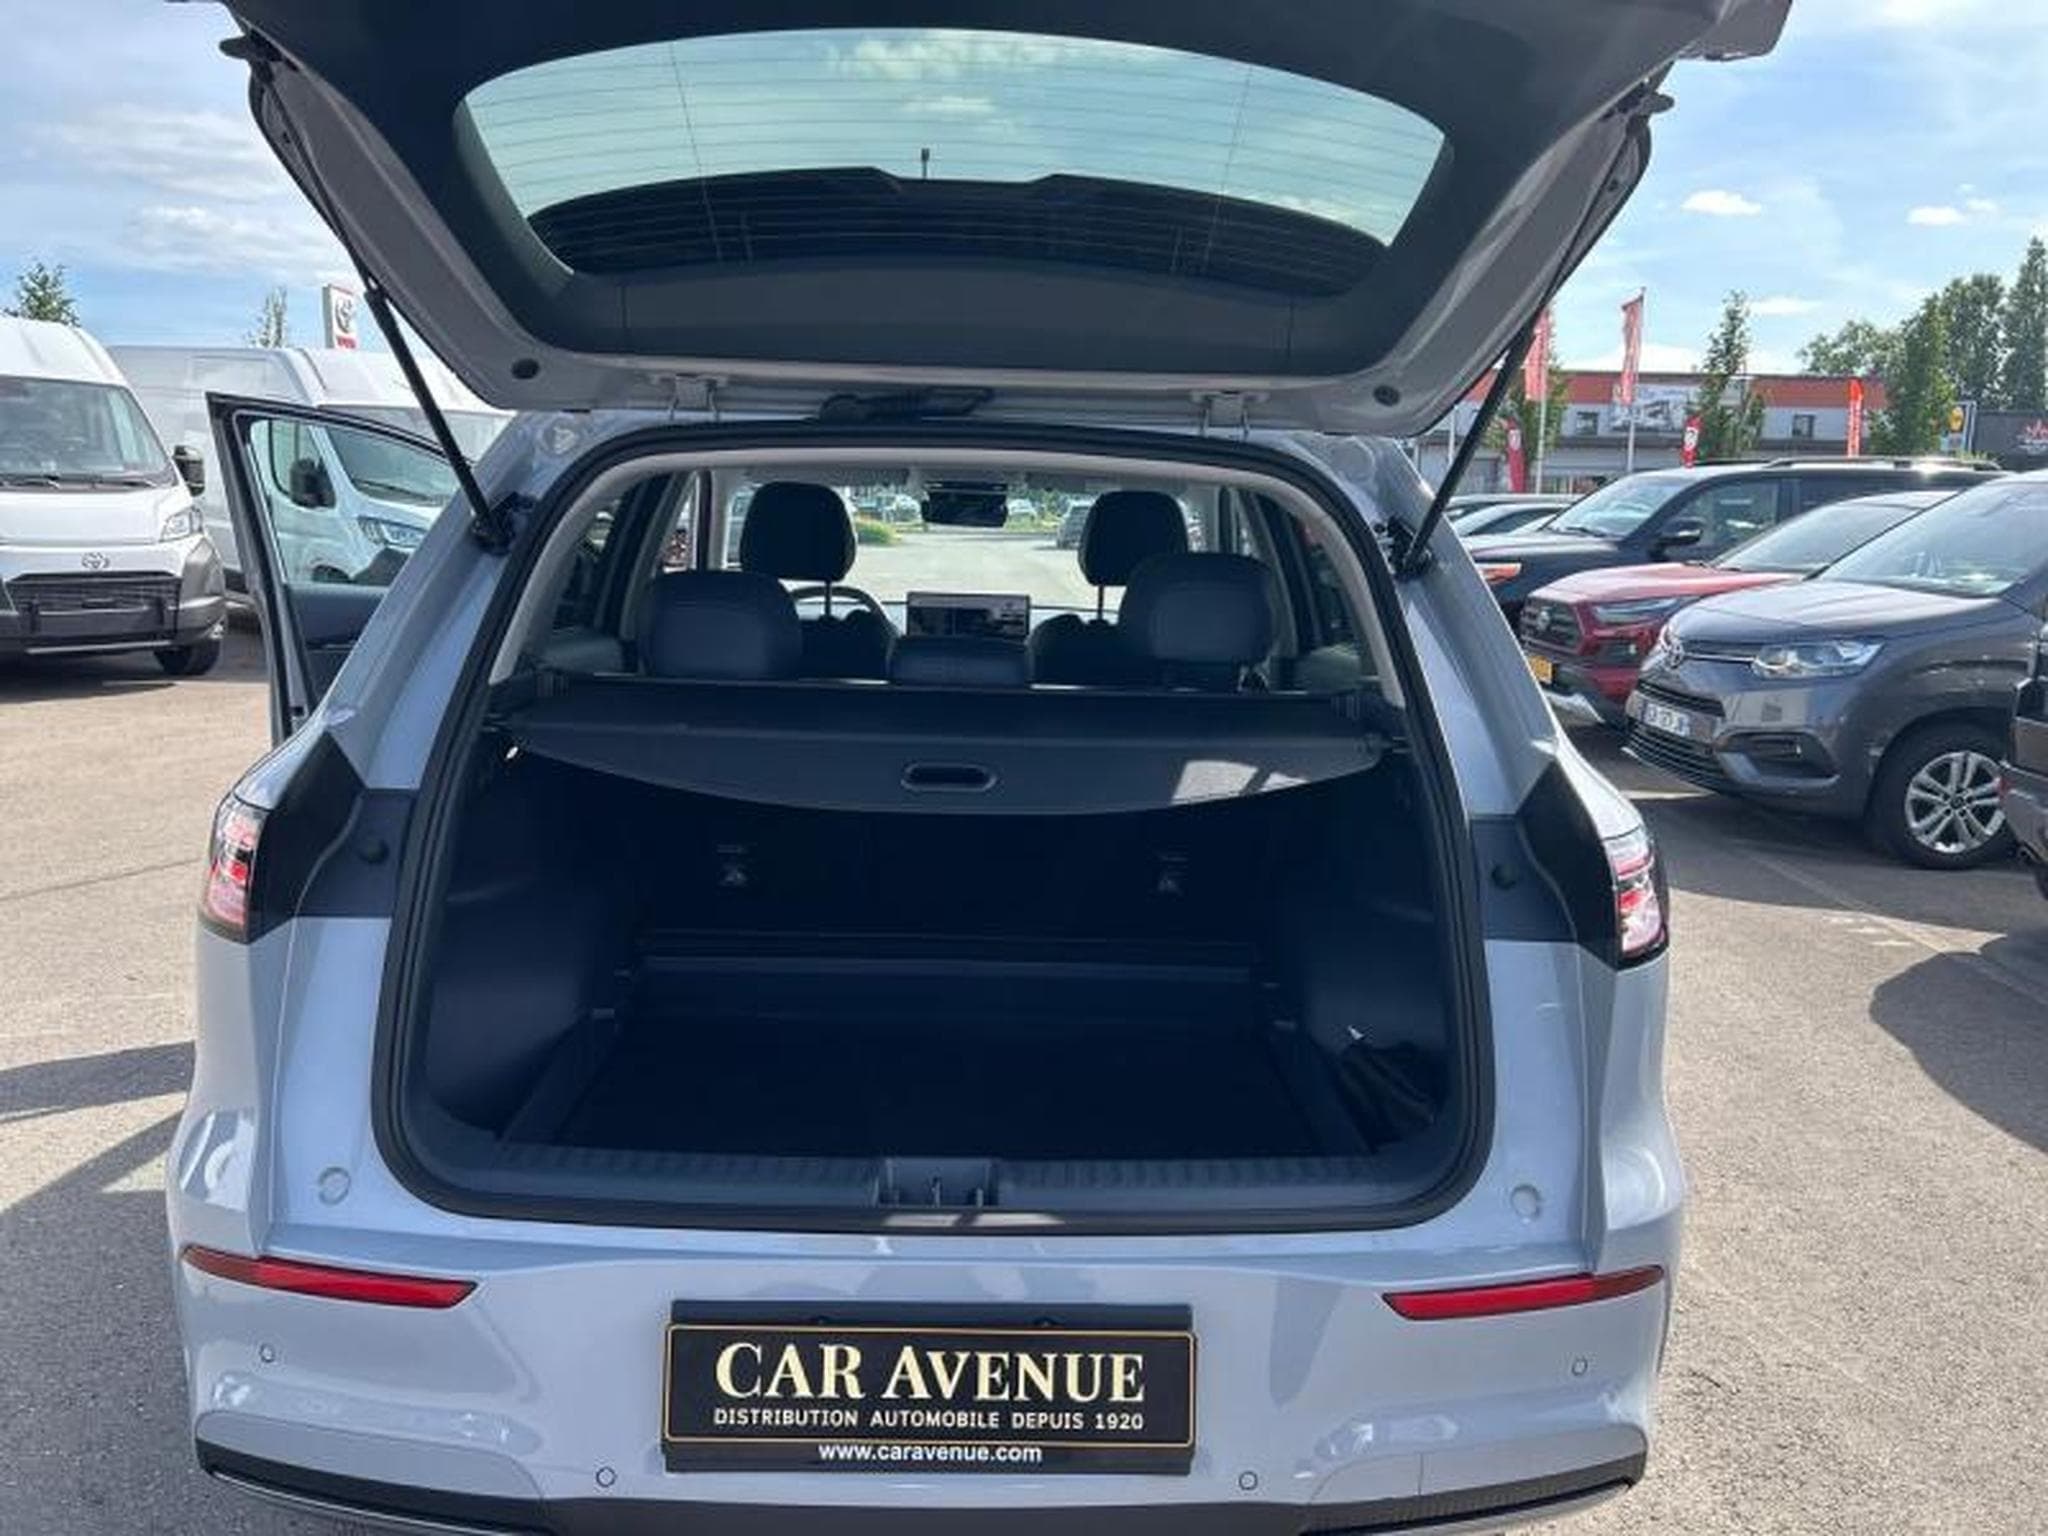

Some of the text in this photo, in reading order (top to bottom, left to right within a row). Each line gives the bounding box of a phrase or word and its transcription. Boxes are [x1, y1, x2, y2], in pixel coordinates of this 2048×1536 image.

[714, 1342, 1146, 1403] CAR AVENUE
[713, 1407, 1144, 1430] DISTRIBUTION AUTOMOBILE DEPUIS 1920
[818, 1441, 1043, 1463] www.caravenue.com
